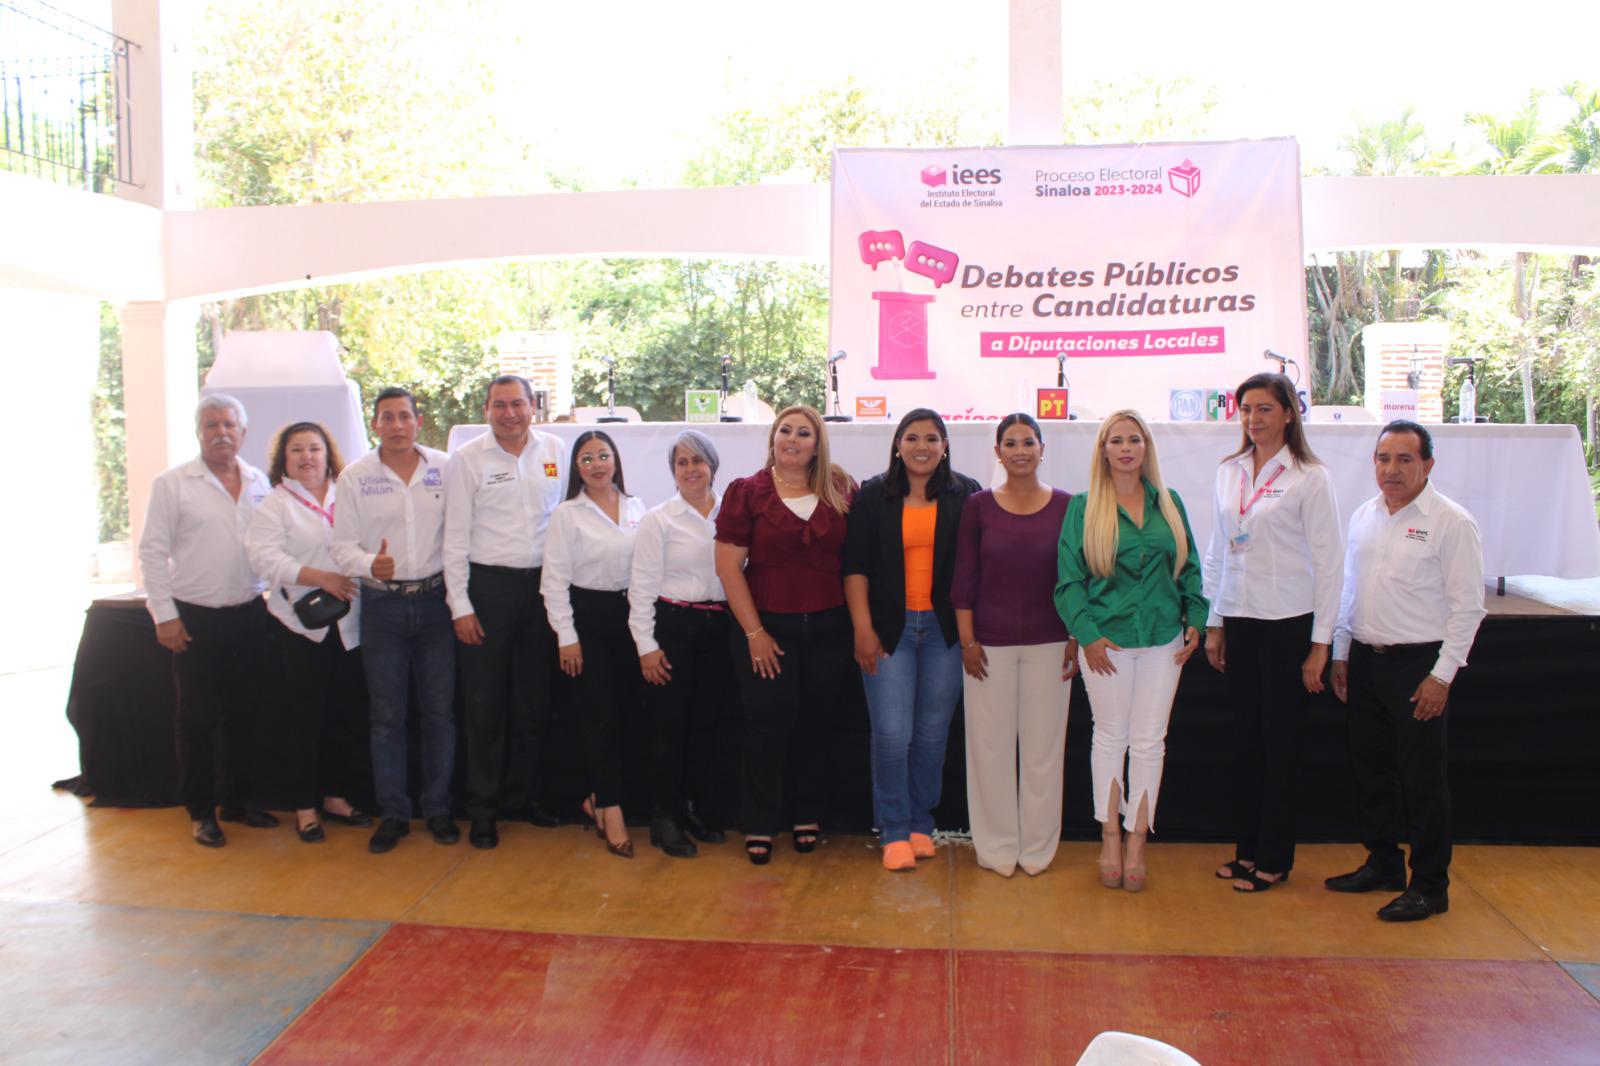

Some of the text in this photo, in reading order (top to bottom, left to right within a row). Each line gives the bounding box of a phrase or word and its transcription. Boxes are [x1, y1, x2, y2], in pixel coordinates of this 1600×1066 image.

[952, 164, 1002, 185] iees
[1035, 166, 1162, 182] Proceso Electoral
[927, 189, 996, 198] Instituto Electoral
[1035, 184, 1163, 197] Sinaloa 2023-2024
[920, 200, 932, 208] del
[933, 200, 961, 208] Estado
[974, 199, 1003, 207] Sinaloa
[960, 262, 1239, 289] Debates Públicos
[960, 292, 1256, 318] entre Candidaturas
[991, 332, 1219, 355] a Diputaciones Locales
[1040, 399, 1065, 417] PT
[1175, 398, 1198, 412] PAN
[1209, 394, 1233, 414] PRI
